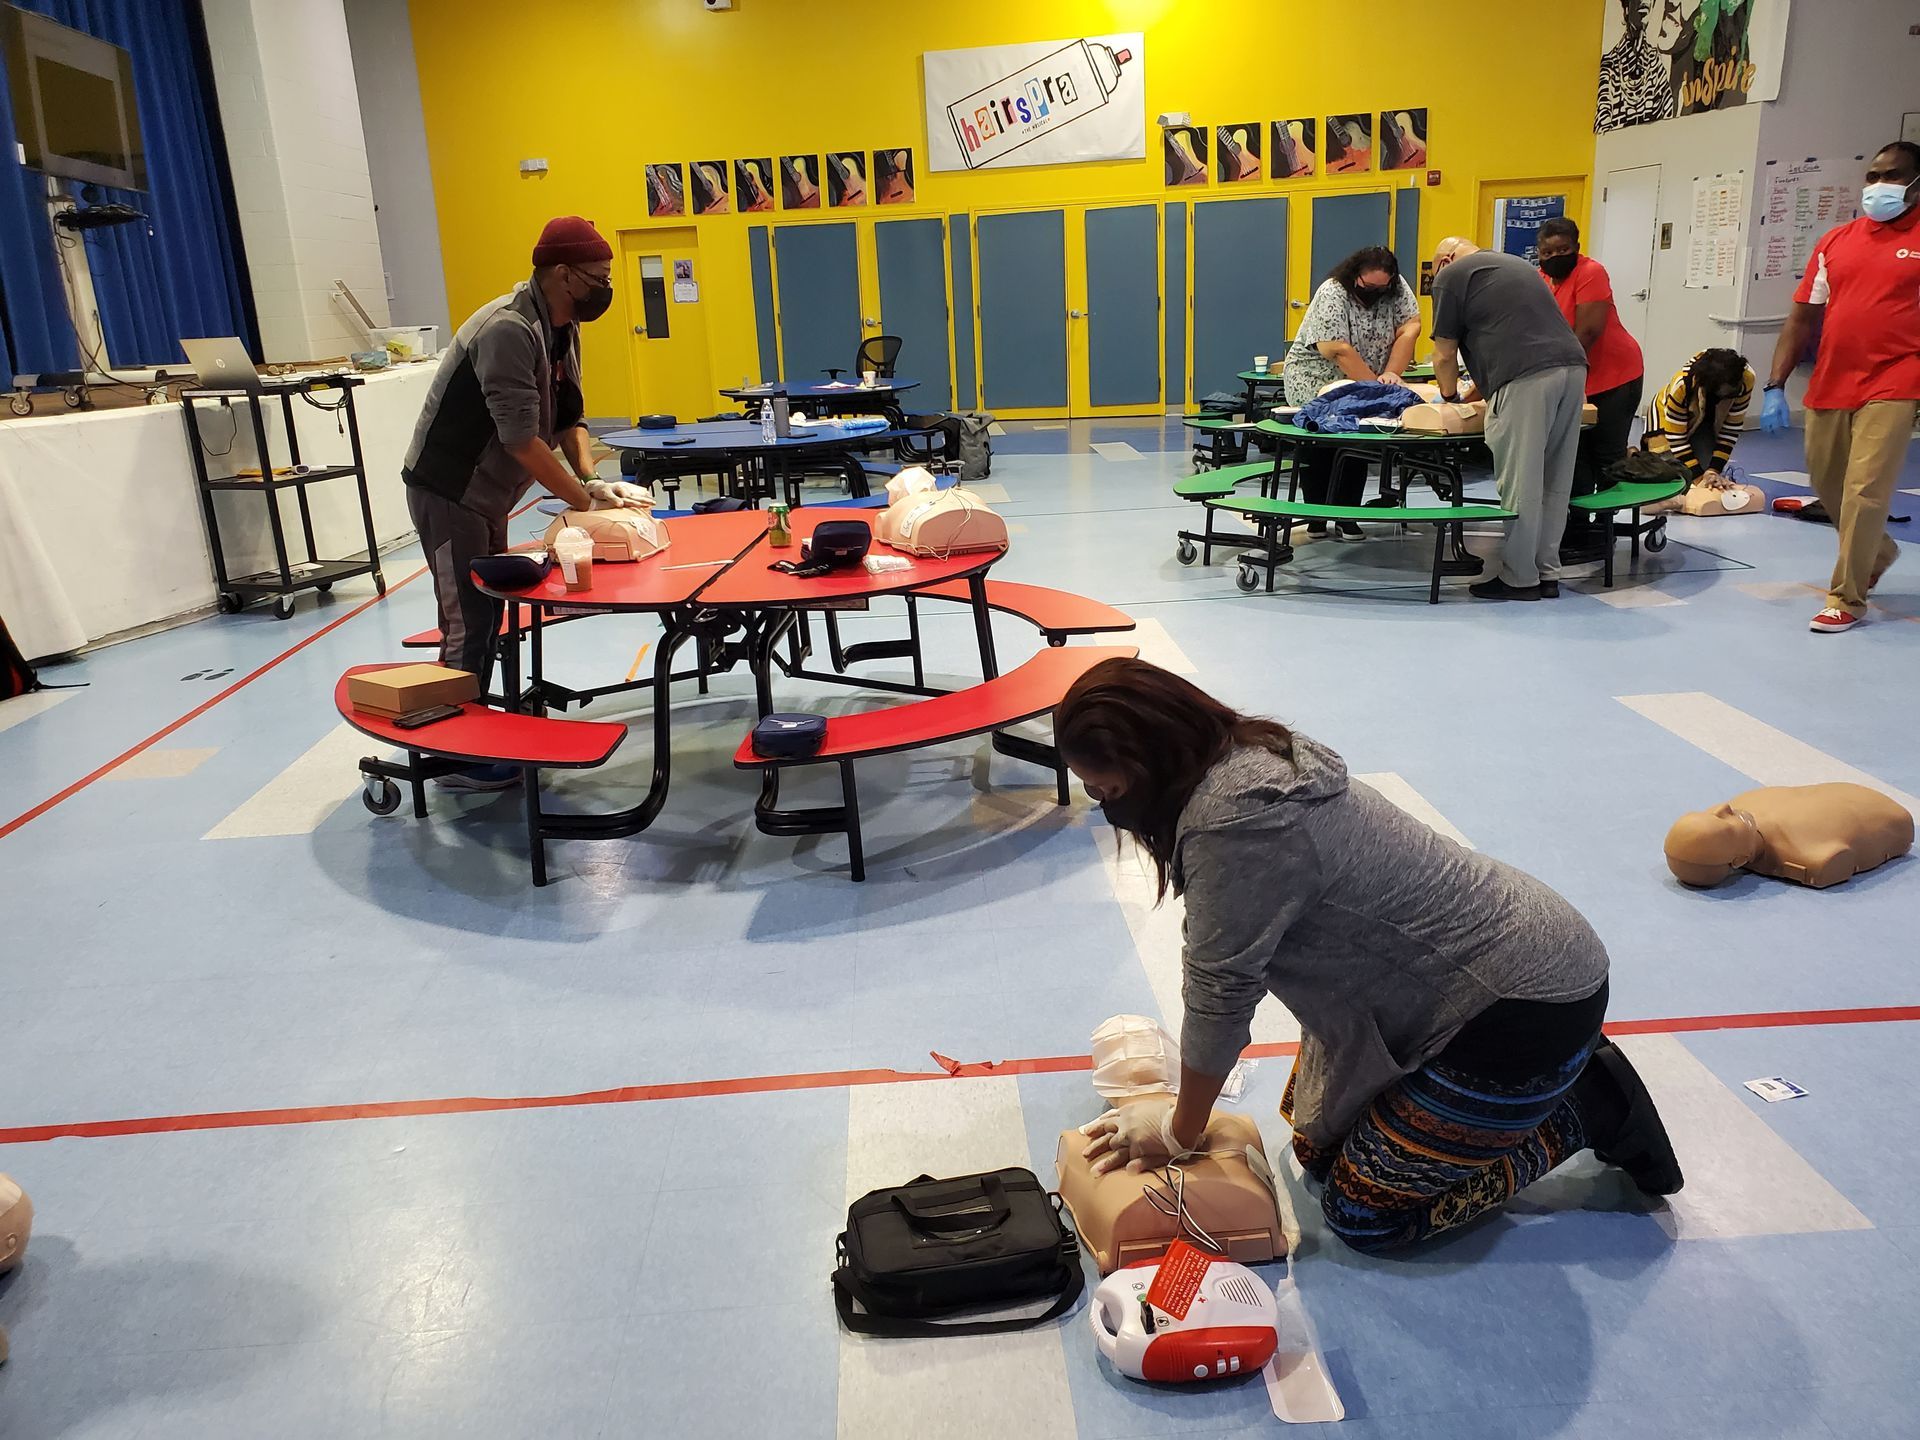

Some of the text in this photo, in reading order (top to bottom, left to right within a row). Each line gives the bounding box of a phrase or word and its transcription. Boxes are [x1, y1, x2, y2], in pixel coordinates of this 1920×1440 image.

[960, 72, 1078, 152] hairspra
[1179, 1259, 1208, 1316] Not For Clinical Use
